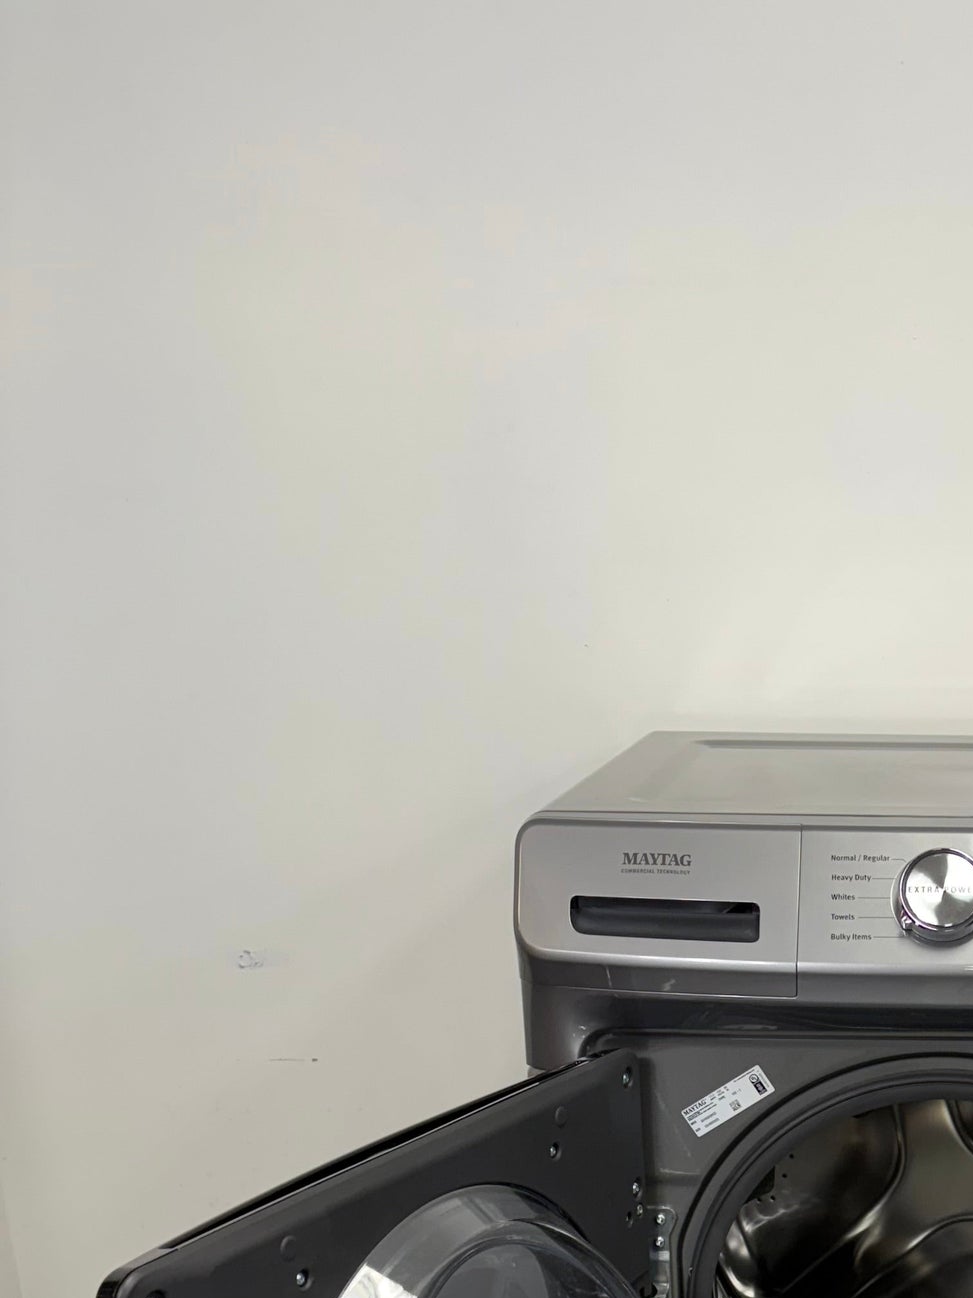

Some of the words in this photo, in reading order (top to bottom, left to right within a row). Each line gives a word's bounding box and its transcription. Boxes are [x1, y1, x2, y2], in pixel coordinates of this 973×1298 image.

[622, 852, 692, 867] MAYTAG
[863, 854, 890, 862] Regular
[831, 874, 853, 882] Heavy
[854, 874, 872, 882] Duty
[831, 933, 851, 942] Bulky
[683, 1099, 707, 1115] MAYTAG
